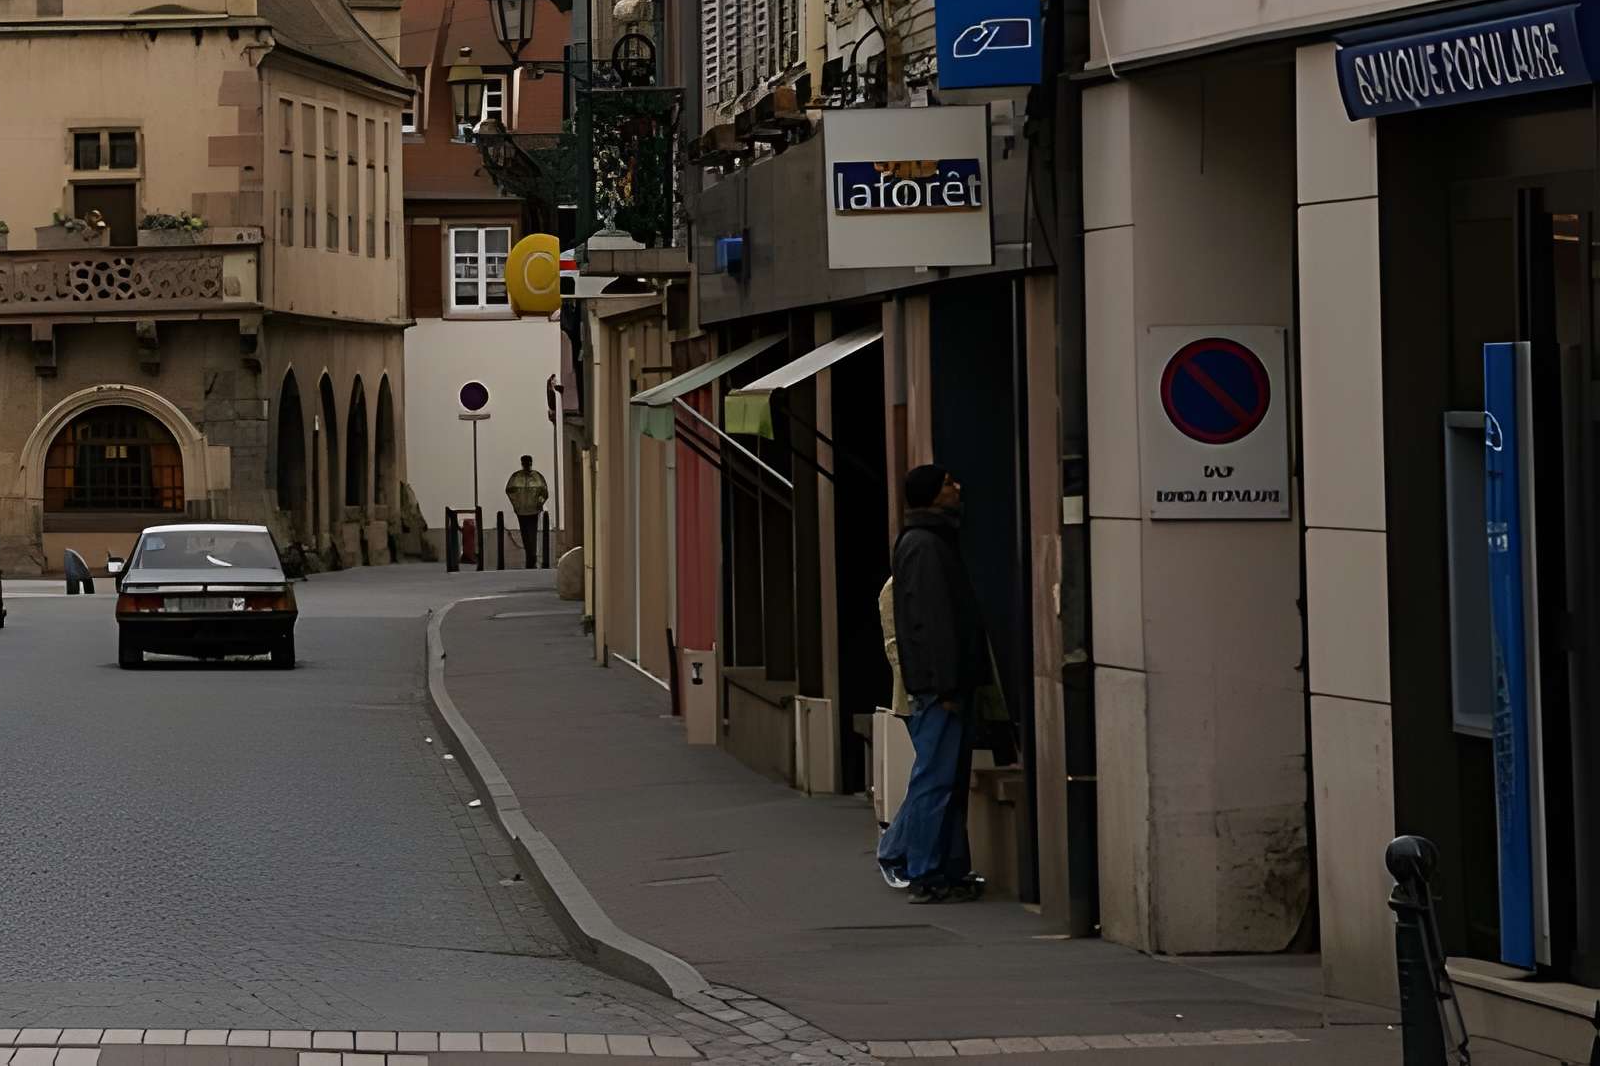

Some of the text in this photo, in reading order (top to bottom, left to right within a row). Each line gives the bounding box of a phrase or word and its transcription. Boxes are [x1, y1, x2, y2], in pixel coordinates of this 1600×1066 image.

[1354, 22, 1566, 108] BANQUE POPULAIRE
[837, 170, 982, 211] laforêt
